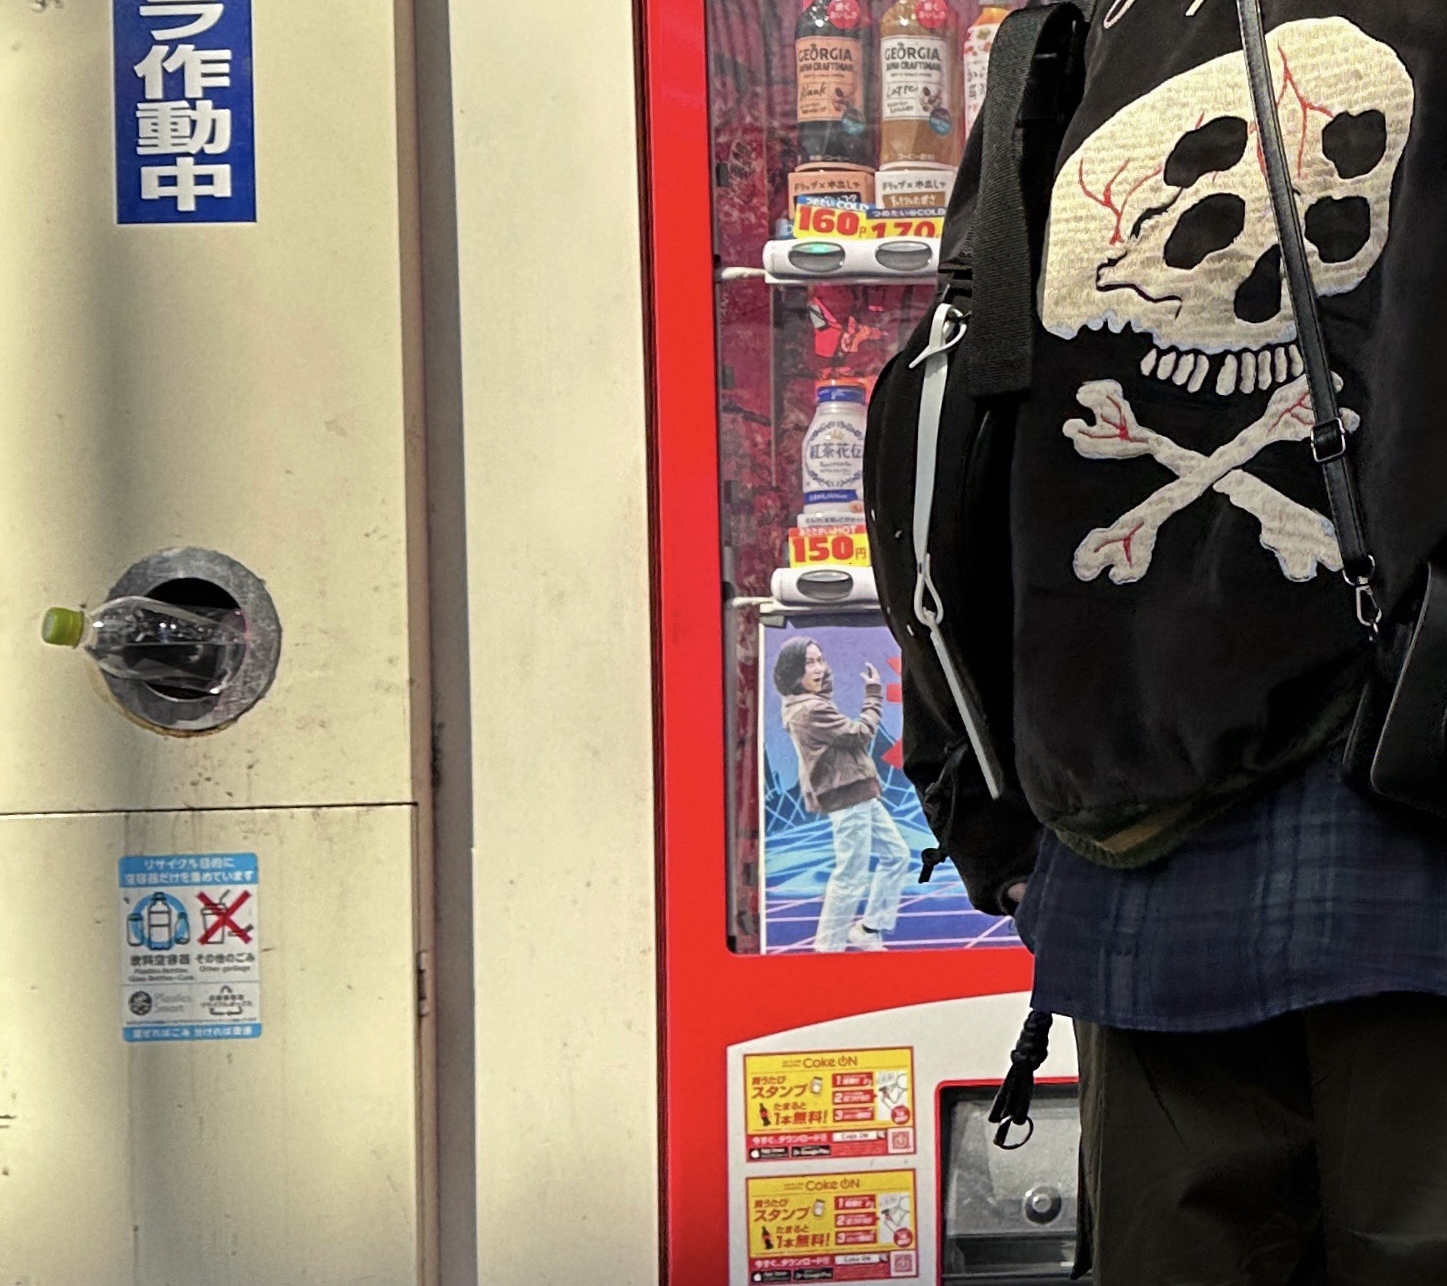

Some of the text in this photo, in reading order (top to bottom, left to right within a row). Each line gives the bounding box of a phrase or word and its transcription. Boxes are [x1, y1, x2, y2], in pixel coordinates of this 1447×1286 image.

[799, 43, 852, 62] GEORGIA
[884, 42, 941, 61] GEORGIA
[838, 201, 869, 211] COLD
[916, 209, 945, 217] COLD
[196, 952, 255, 964] その他のごみ
[803, 1056, 836, 1069] Coke
[752, 1083, 808, 1099] スタンプ
[805, 1179, 839, 1192] Coke
[754, 1206, 811, 1222] スタンプ
